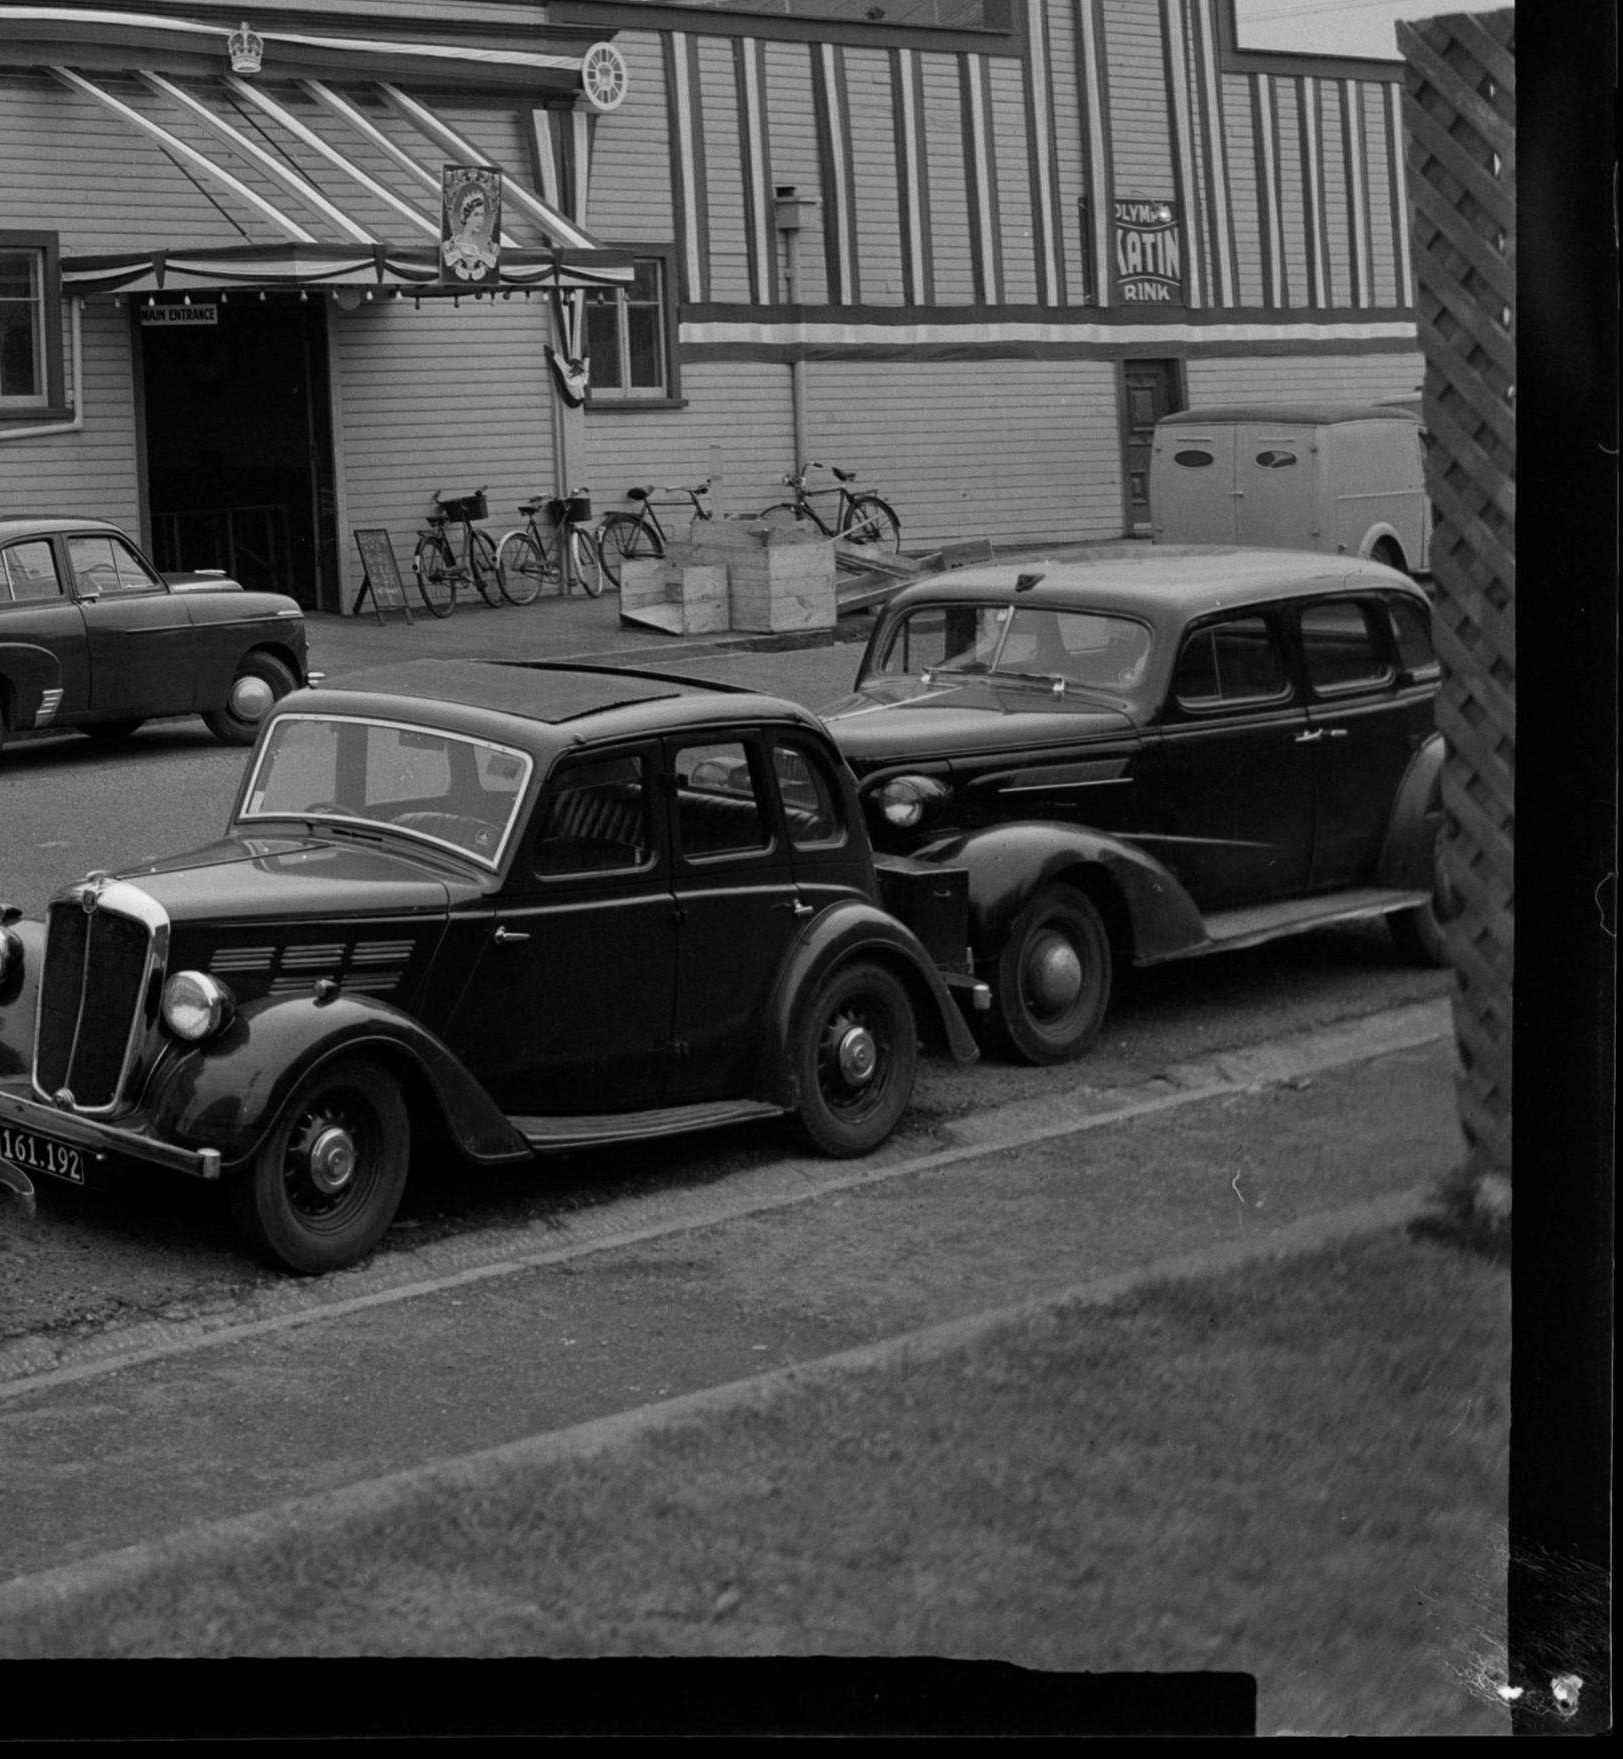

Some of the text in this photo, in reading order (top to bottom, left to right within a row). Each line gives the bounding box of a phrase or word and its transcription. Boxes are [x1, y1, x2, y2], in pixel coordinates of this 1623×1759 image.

[1124, 282, 1170, 301] RINK
[168, 307, 216, 321] ENTRANCE
[3, 1128, 81, 1180] 161.192
